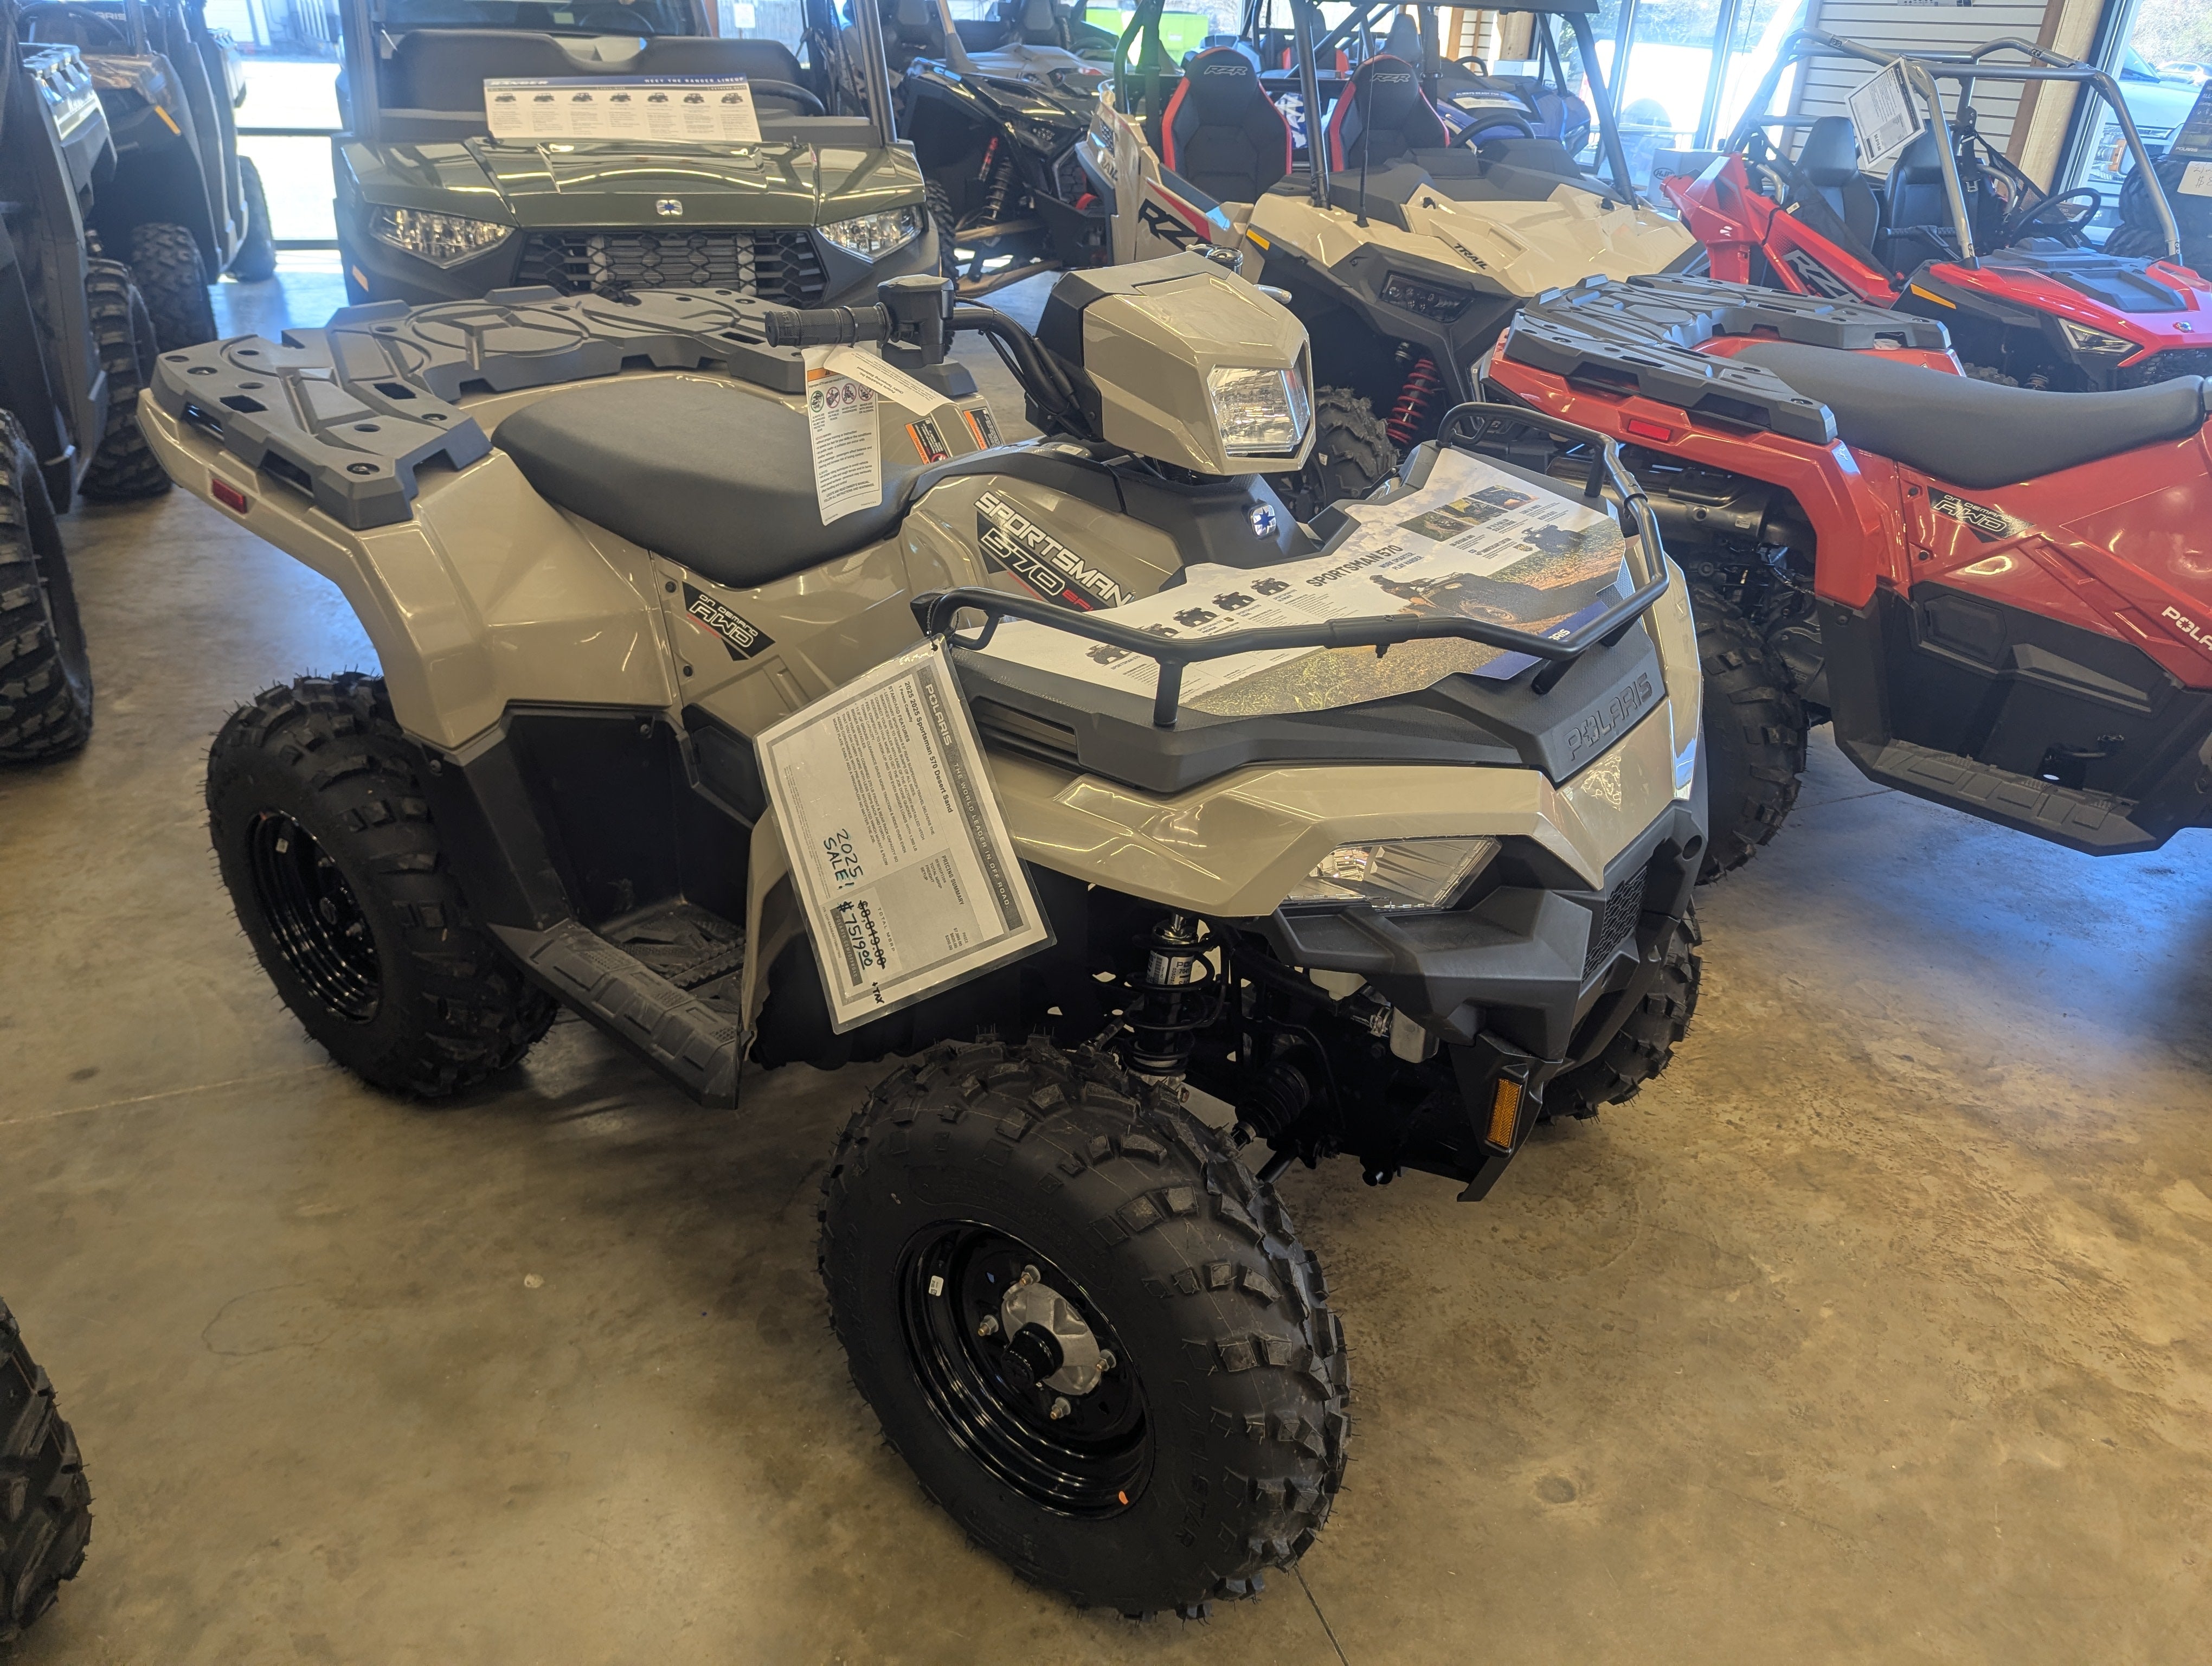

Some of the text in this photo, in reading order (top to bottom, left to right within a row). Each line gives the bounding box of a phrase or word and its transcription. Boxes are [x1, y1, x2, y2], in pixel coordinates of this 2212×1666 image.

[1204, 65, 1248, 75] RZR
[1369, 73, 1410, 83] RZR
[1138, 198, 1213, 252] RZ
[1454, 243, 1487, 270] TRAIL
[856, 366, 874, 377] Statement
[882, 385, 896, 393] Polaris
[913, 437, 928, 461] WARNING
[1933, 499, 2007, 532] AWD
[1964, 502, 2013, 522] DEMAND
[975, 492, 1134, 607] SPORTSMAN
[981, 527, 1066, 595] 570
[1306, 544, 1404, 587] SPORTSMAN 570
[1391, 552, 1416, 564] SMARTER.
[1392, 555, 1425, 571] PLAY HARDER.
[689, 600, 754, 648] AWD
[699, 594, 715, 607] ON
[718, 606, 758, 637] DEMAND
[1110, 658, 1134, 670] SPORTSMAN
[888, 685, 910, 742] STANDARD FEATURES
[898, 688, 907, 703] Person
[904, 703, 913, 723] Capacity
[925, 683, 953, 746] POLARIS
[1564, 672, 1652, 761] POLARIS
[879, 694, 890, 720] SMOOTHEST
[893, 736, 901, 754] ABSORB
[898, 753, 906, 768] BUMPS
[904, 681, 953, 813] 2025 2025 Sportsman 570 Desert Sand
[860, 722, 869, 741] GROUND
[866, 740, 877, 765] CLEARANCE
[883, 791, 892, 812] TRACTION
[874, 696, 883, 716] CONNECT
[884, 729, 893, 746] TRAILER
[903, 784, 920, 826] FACTORY-INSTALLED
[883, 691, 894, 717] LEGENDARY
[892, 717, 903, 742] SPORTSMAN
[907, 762, 918, 789] SUSPENSION
[916, 789, 924, 805] TRAVEL
[922, 805, 931, 826] DELIVERS
[835, 826, 863, 880] 2025
[953, 762, 1011, 908] THE WORLD LEADER IN OFF ROAD.
[822, 834, 854, 890] SALE!
[924, 864, 934, 883] FREIGHT
[941, 855, 964, 905] PRICING SUMMARY
[877, 907, 895, 952] TOTAL MSRP
